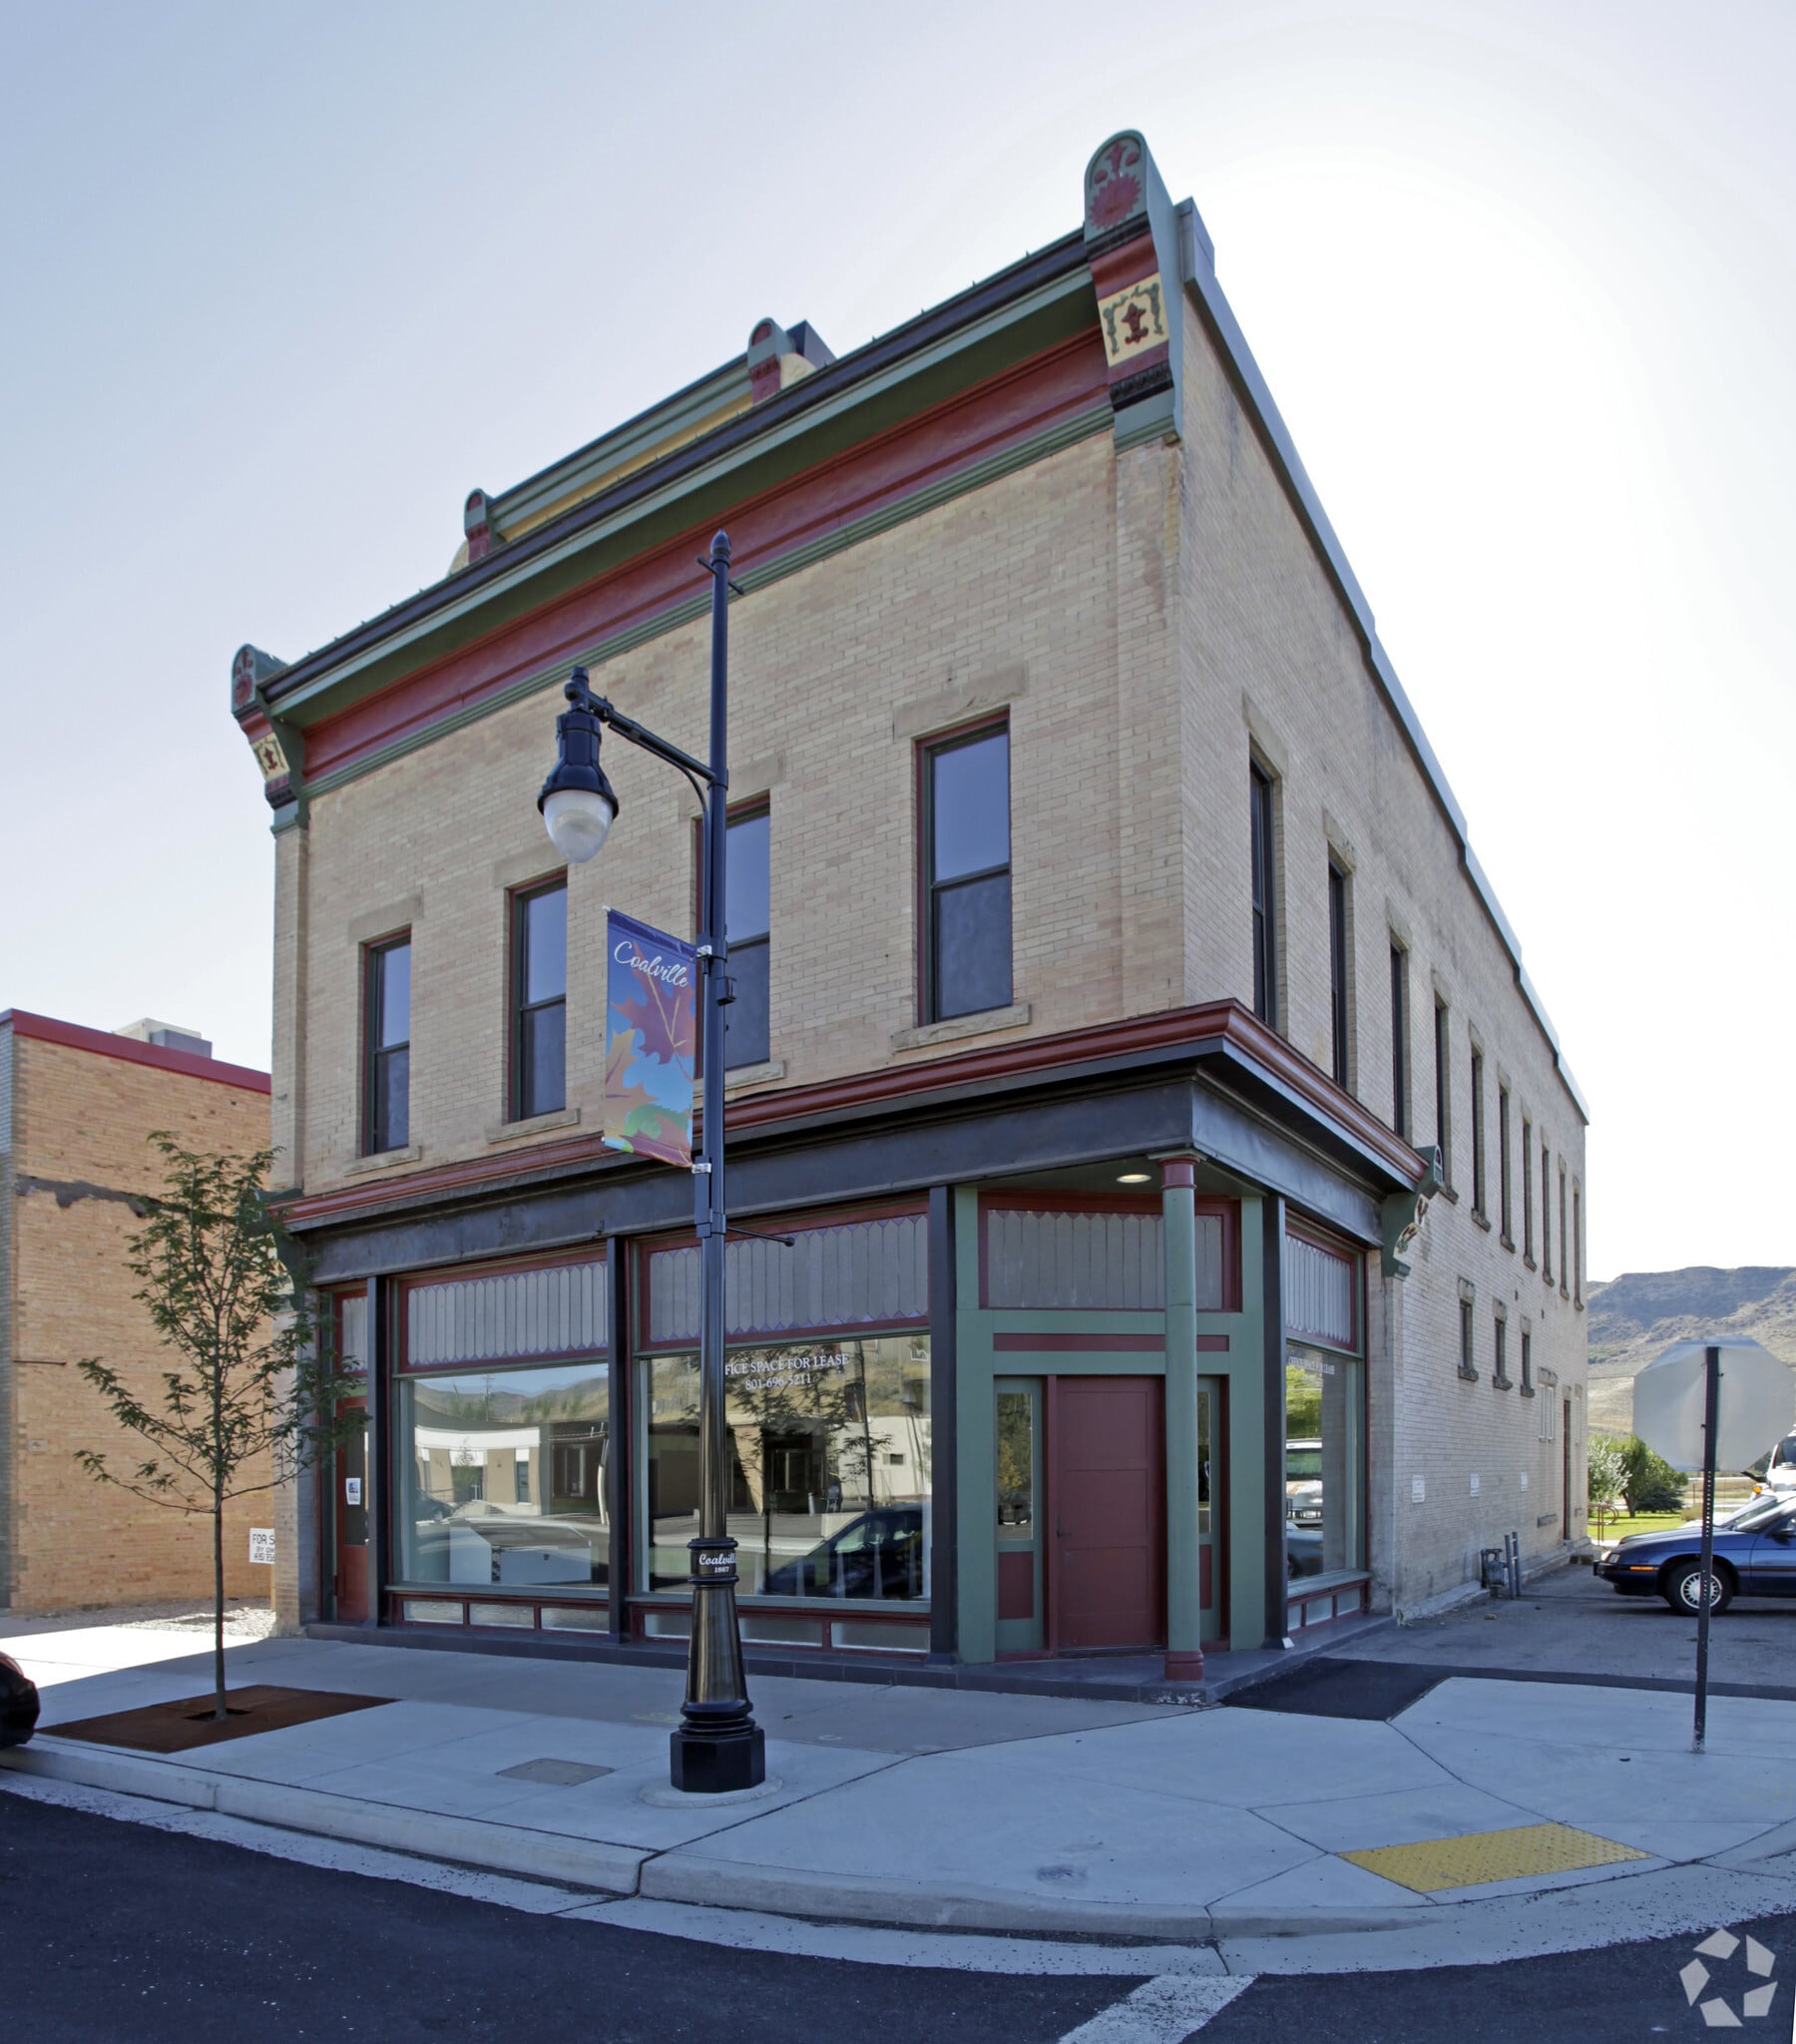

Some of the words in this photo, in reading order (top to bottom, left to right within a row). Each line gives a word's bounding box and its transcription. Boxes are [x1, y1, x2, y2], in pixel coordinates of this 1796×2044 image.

[614, 941, 688, 987] Coalville
[725, 1362, 748, 1375] FICE
[750, 1360, 784, 1373] SPACE
[787, 1356, 810, 1369] FOR
[813, 1353, 849, 1368] LEASE
[745, 1373, 812, 1390] 801-696-5211
[252, 1533, 267, 1545] FOR
[698, 1553, 735, 1565] Coalvill
